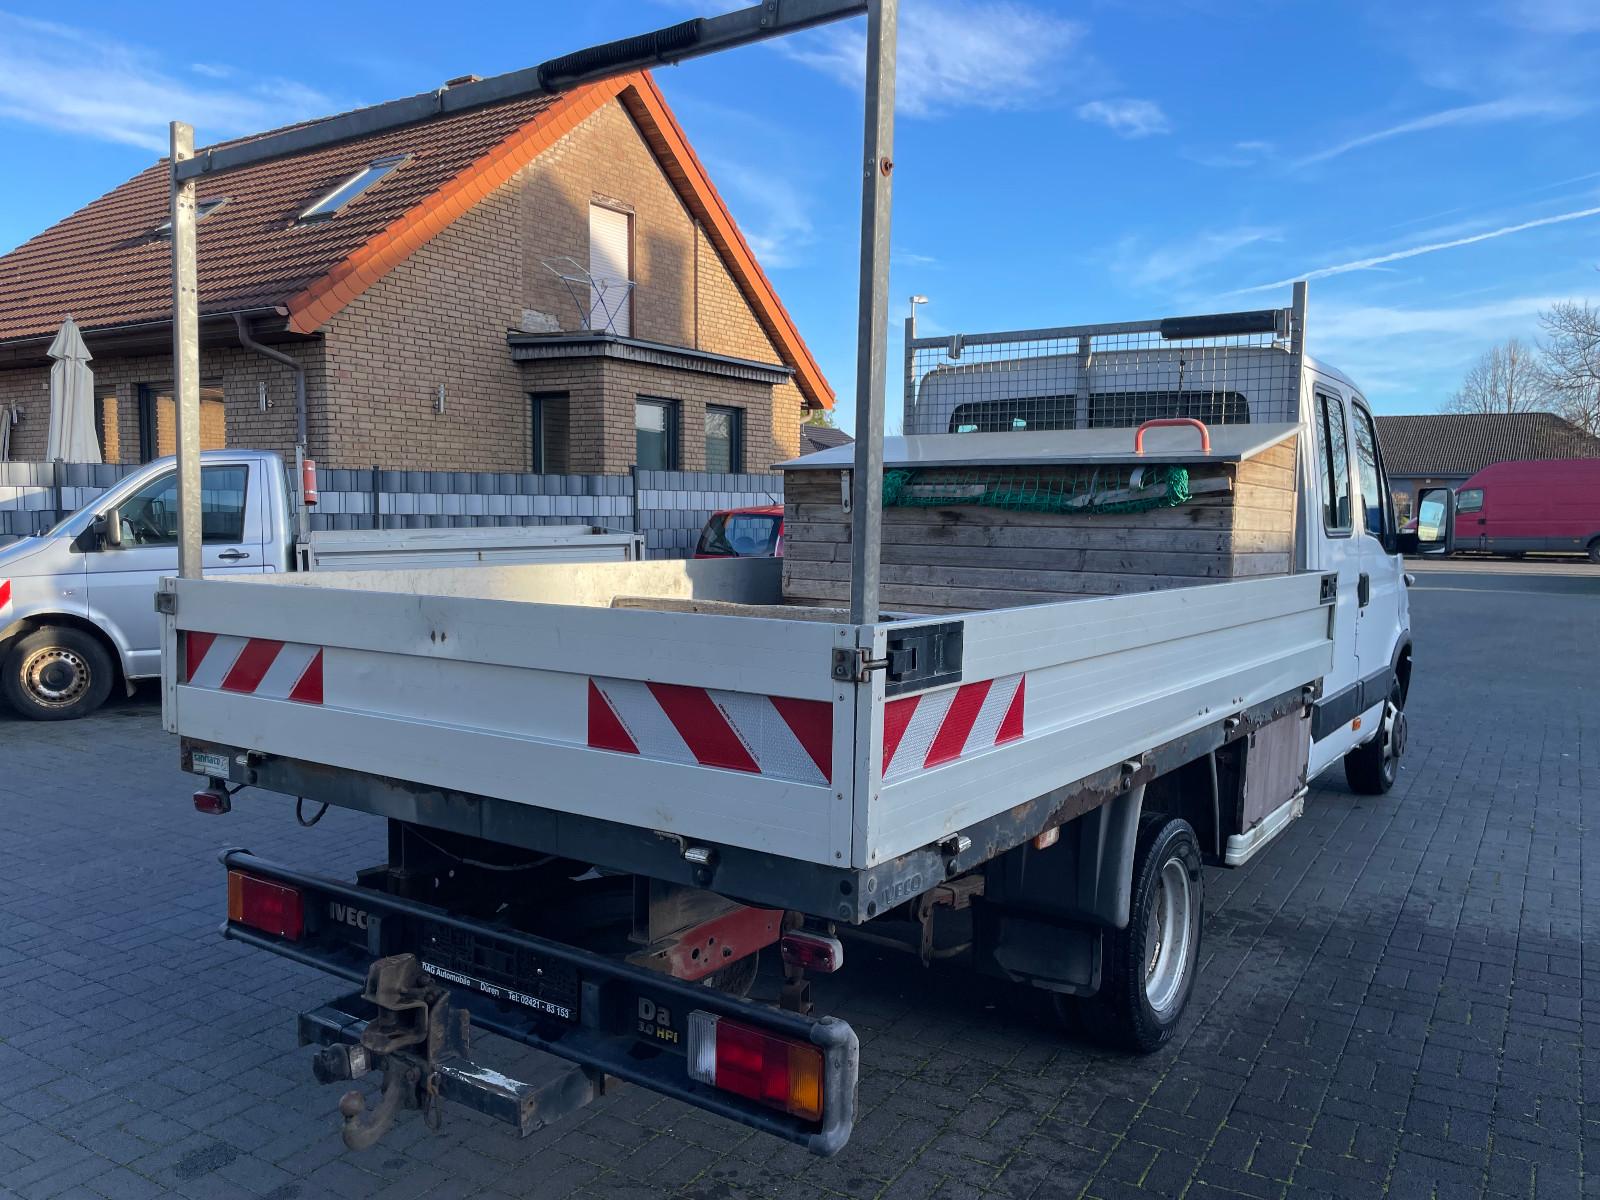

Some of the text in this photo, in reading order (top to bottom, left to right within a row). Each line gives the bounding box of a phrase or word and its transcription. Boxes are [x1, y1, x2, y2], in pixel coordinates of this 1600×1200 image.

[881, 872, 923, 904] IVECO
[329, 902, 368, 930] IVEC
[436, 967, 471, 986] Automobile
[480, 982, 500, 996] Düren
[508, 991, 520, 1002] Tel:
[520, 994, 540, 1008] 02421
[638, 997, 670, 1027] Da
